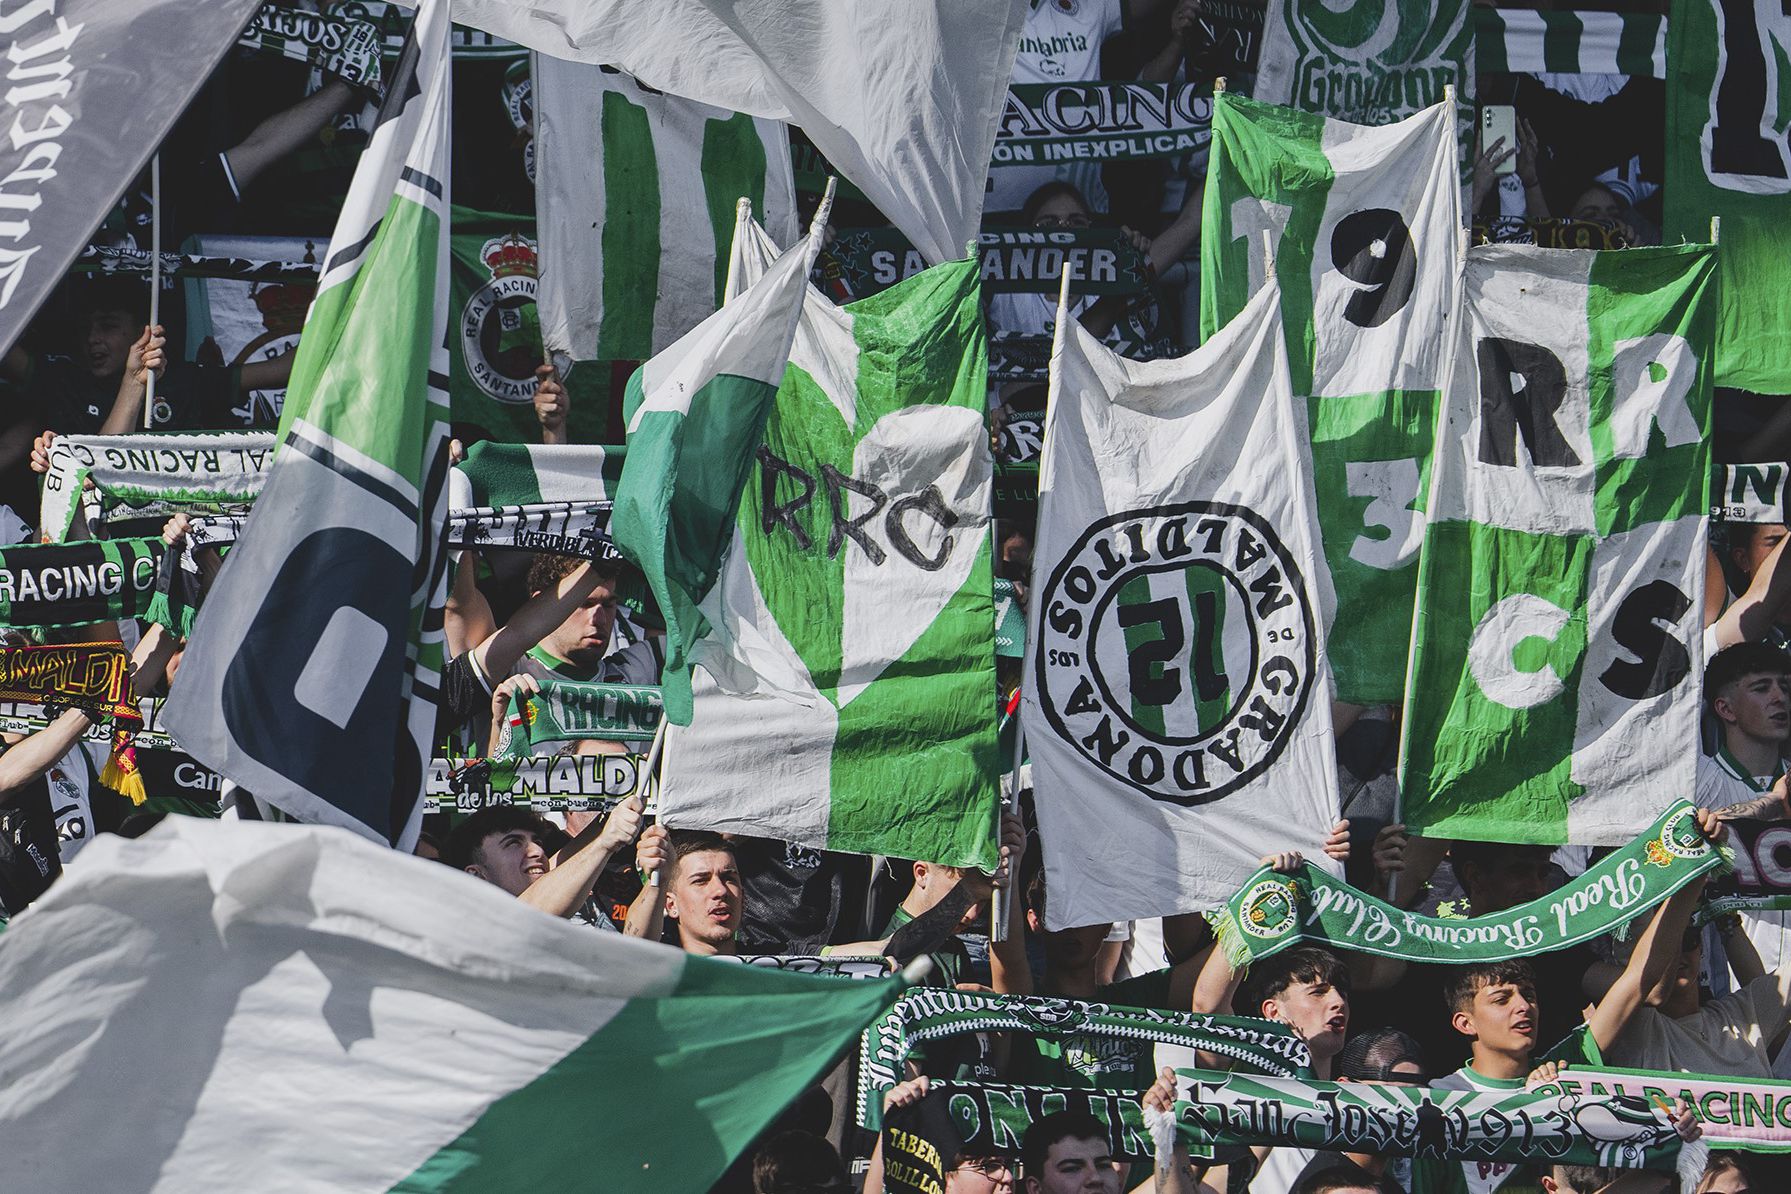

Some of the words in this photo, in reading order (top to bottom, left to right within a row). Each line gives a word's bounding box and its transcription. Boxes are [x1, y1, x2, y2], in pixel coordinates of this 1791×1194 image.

[996, 82, 1213, 137] ACING
[992, 144, 1034, 161] ÓN
[977, 232, 1077, 245] CING
[872, 247, 1117, 285] SAANDER
[466, 299, 492, 338] REAL
[493, 279, 537, 300] RACIN
[105, 448, 220, 474] RACING
[1710, 506, 1746, 518] 913
[1117, 590, 1229, 707] 12
[1267, 626, 1295, 645] DE
[1309, 883, 1401, 948] Club
[1550, 857, 1646, 938] Real
